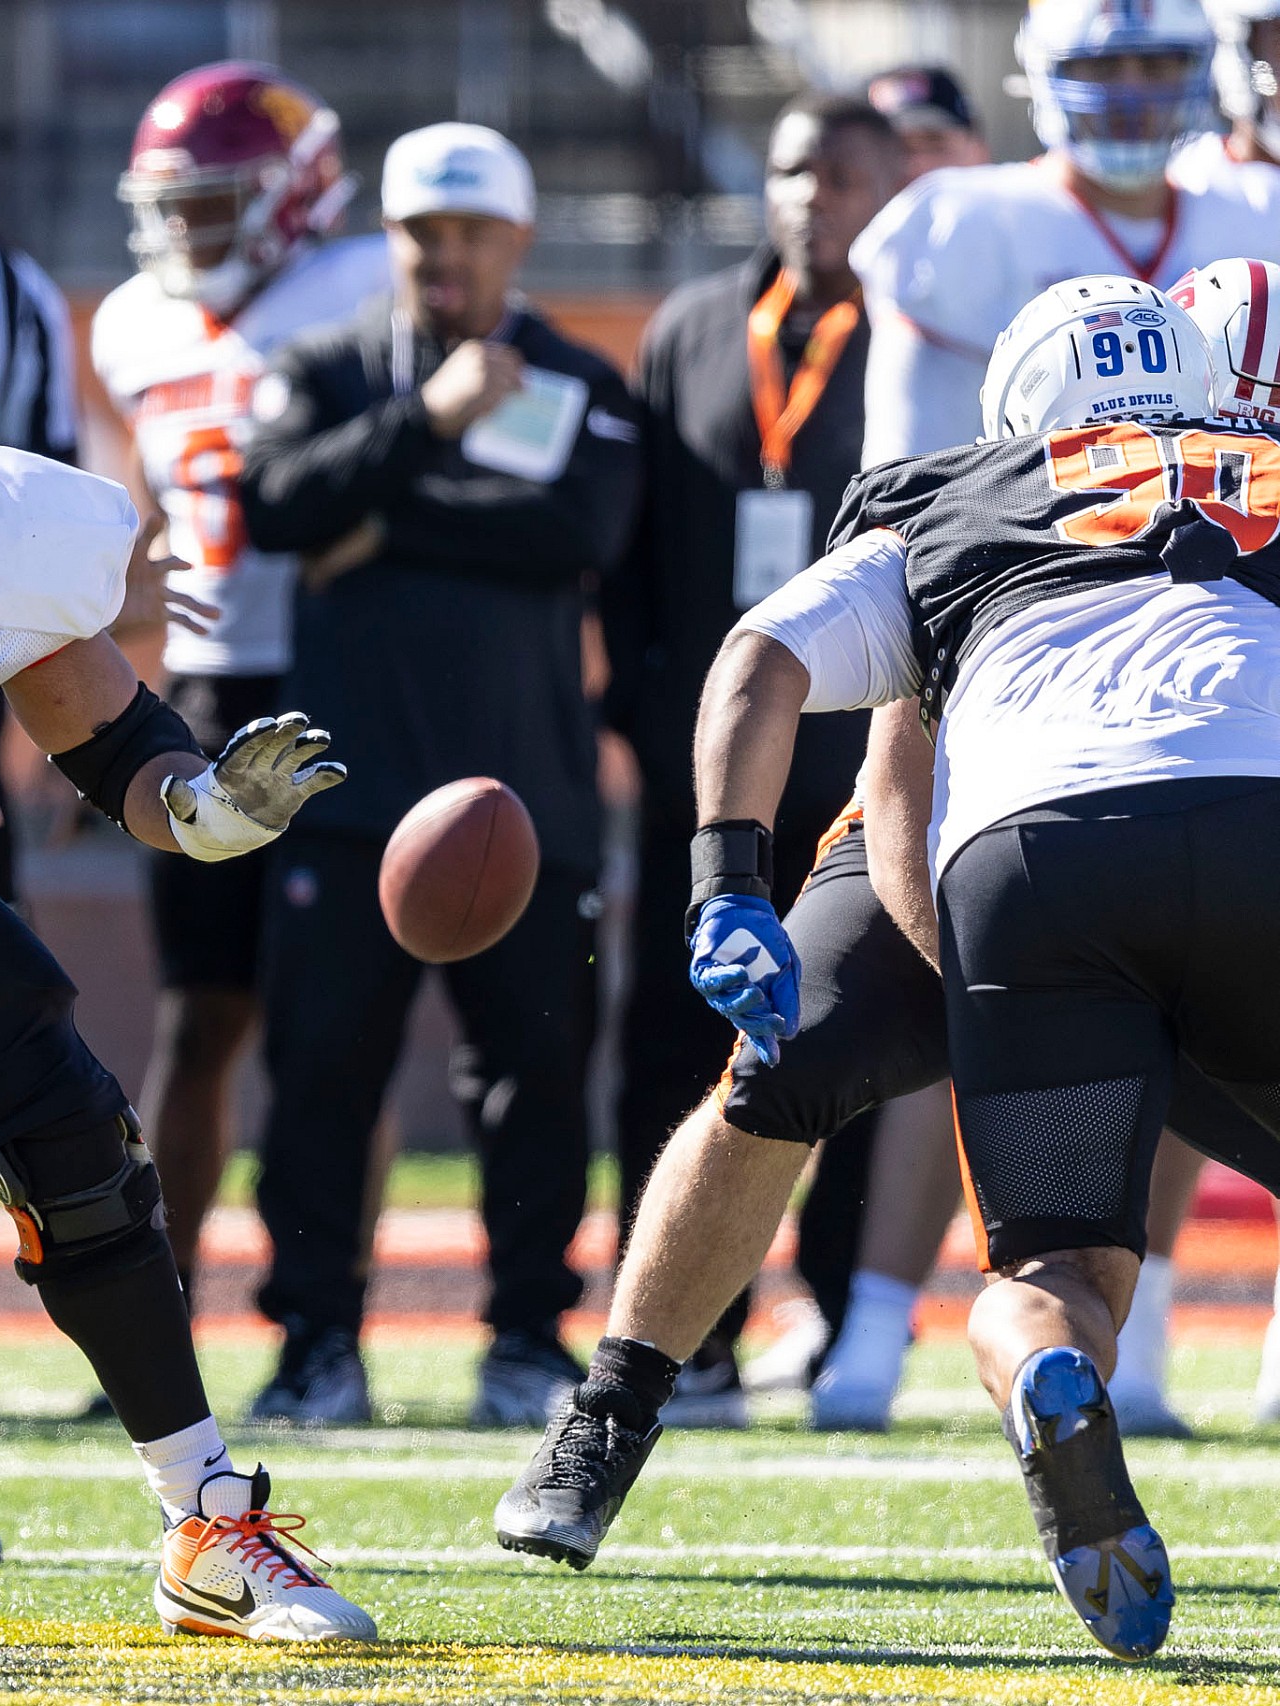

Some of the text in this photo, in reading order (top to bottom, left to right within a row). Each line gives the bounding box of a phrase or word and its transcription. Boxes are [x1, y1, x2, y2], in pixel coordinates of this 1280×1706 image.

[1132, 312, 1160, 323] ACC
[1092, 328, 1167, 378] 90
[1092, 393, 1173, 414] BLUE DEVILS
